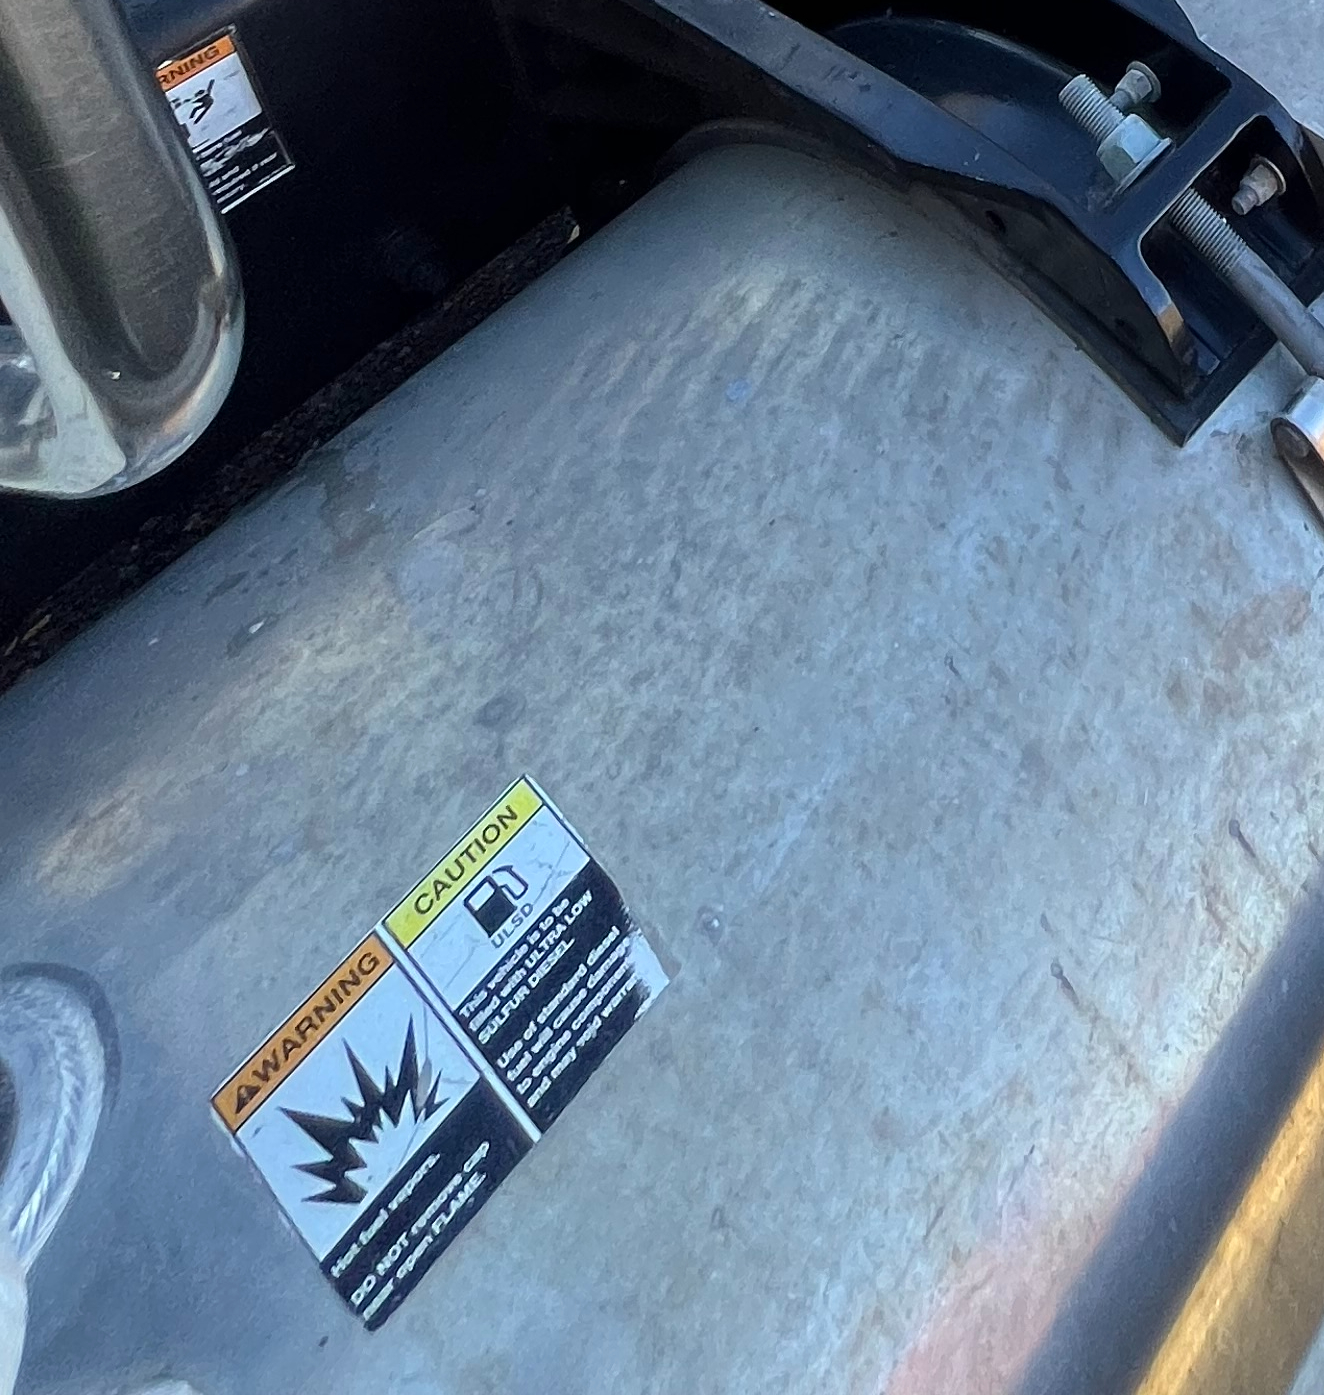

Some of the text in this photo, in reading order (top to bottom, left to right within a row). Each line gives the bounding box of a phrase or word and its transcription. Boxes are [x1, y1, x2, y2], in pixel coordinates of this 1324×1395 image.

[159, 45, 221, 85] RNING
[413, 804, 518, 915] CAUTION
[459, 898, 570, 1018] This vehicle is to be
[468, 889, 593, 1032] filled with ULTRA LOW
[490, 902, 534, 949] ULSD
[252, 951, 380, 1083] WARNING
[477, 988, 531, 1045] SULFUR
[496, 925, 621, 1069] Use of standard diesel
[506, 936, 631, 1082] fuel will cause damage
[516, 1077, 533, 1095] to
[531, 1029, 572, 1077] engine
[526, 1075, 552, 1109] and
[550, 1046, 578, 1079] may
[576, 1015, 602, 1047] void
[330, 1242, 361, 1278] Hot
[359, 1207, 389, 1246] fuel
[350, 1140, 490, 1306] DO NOT remove cap
[396, 1235, 433, 1279] open
